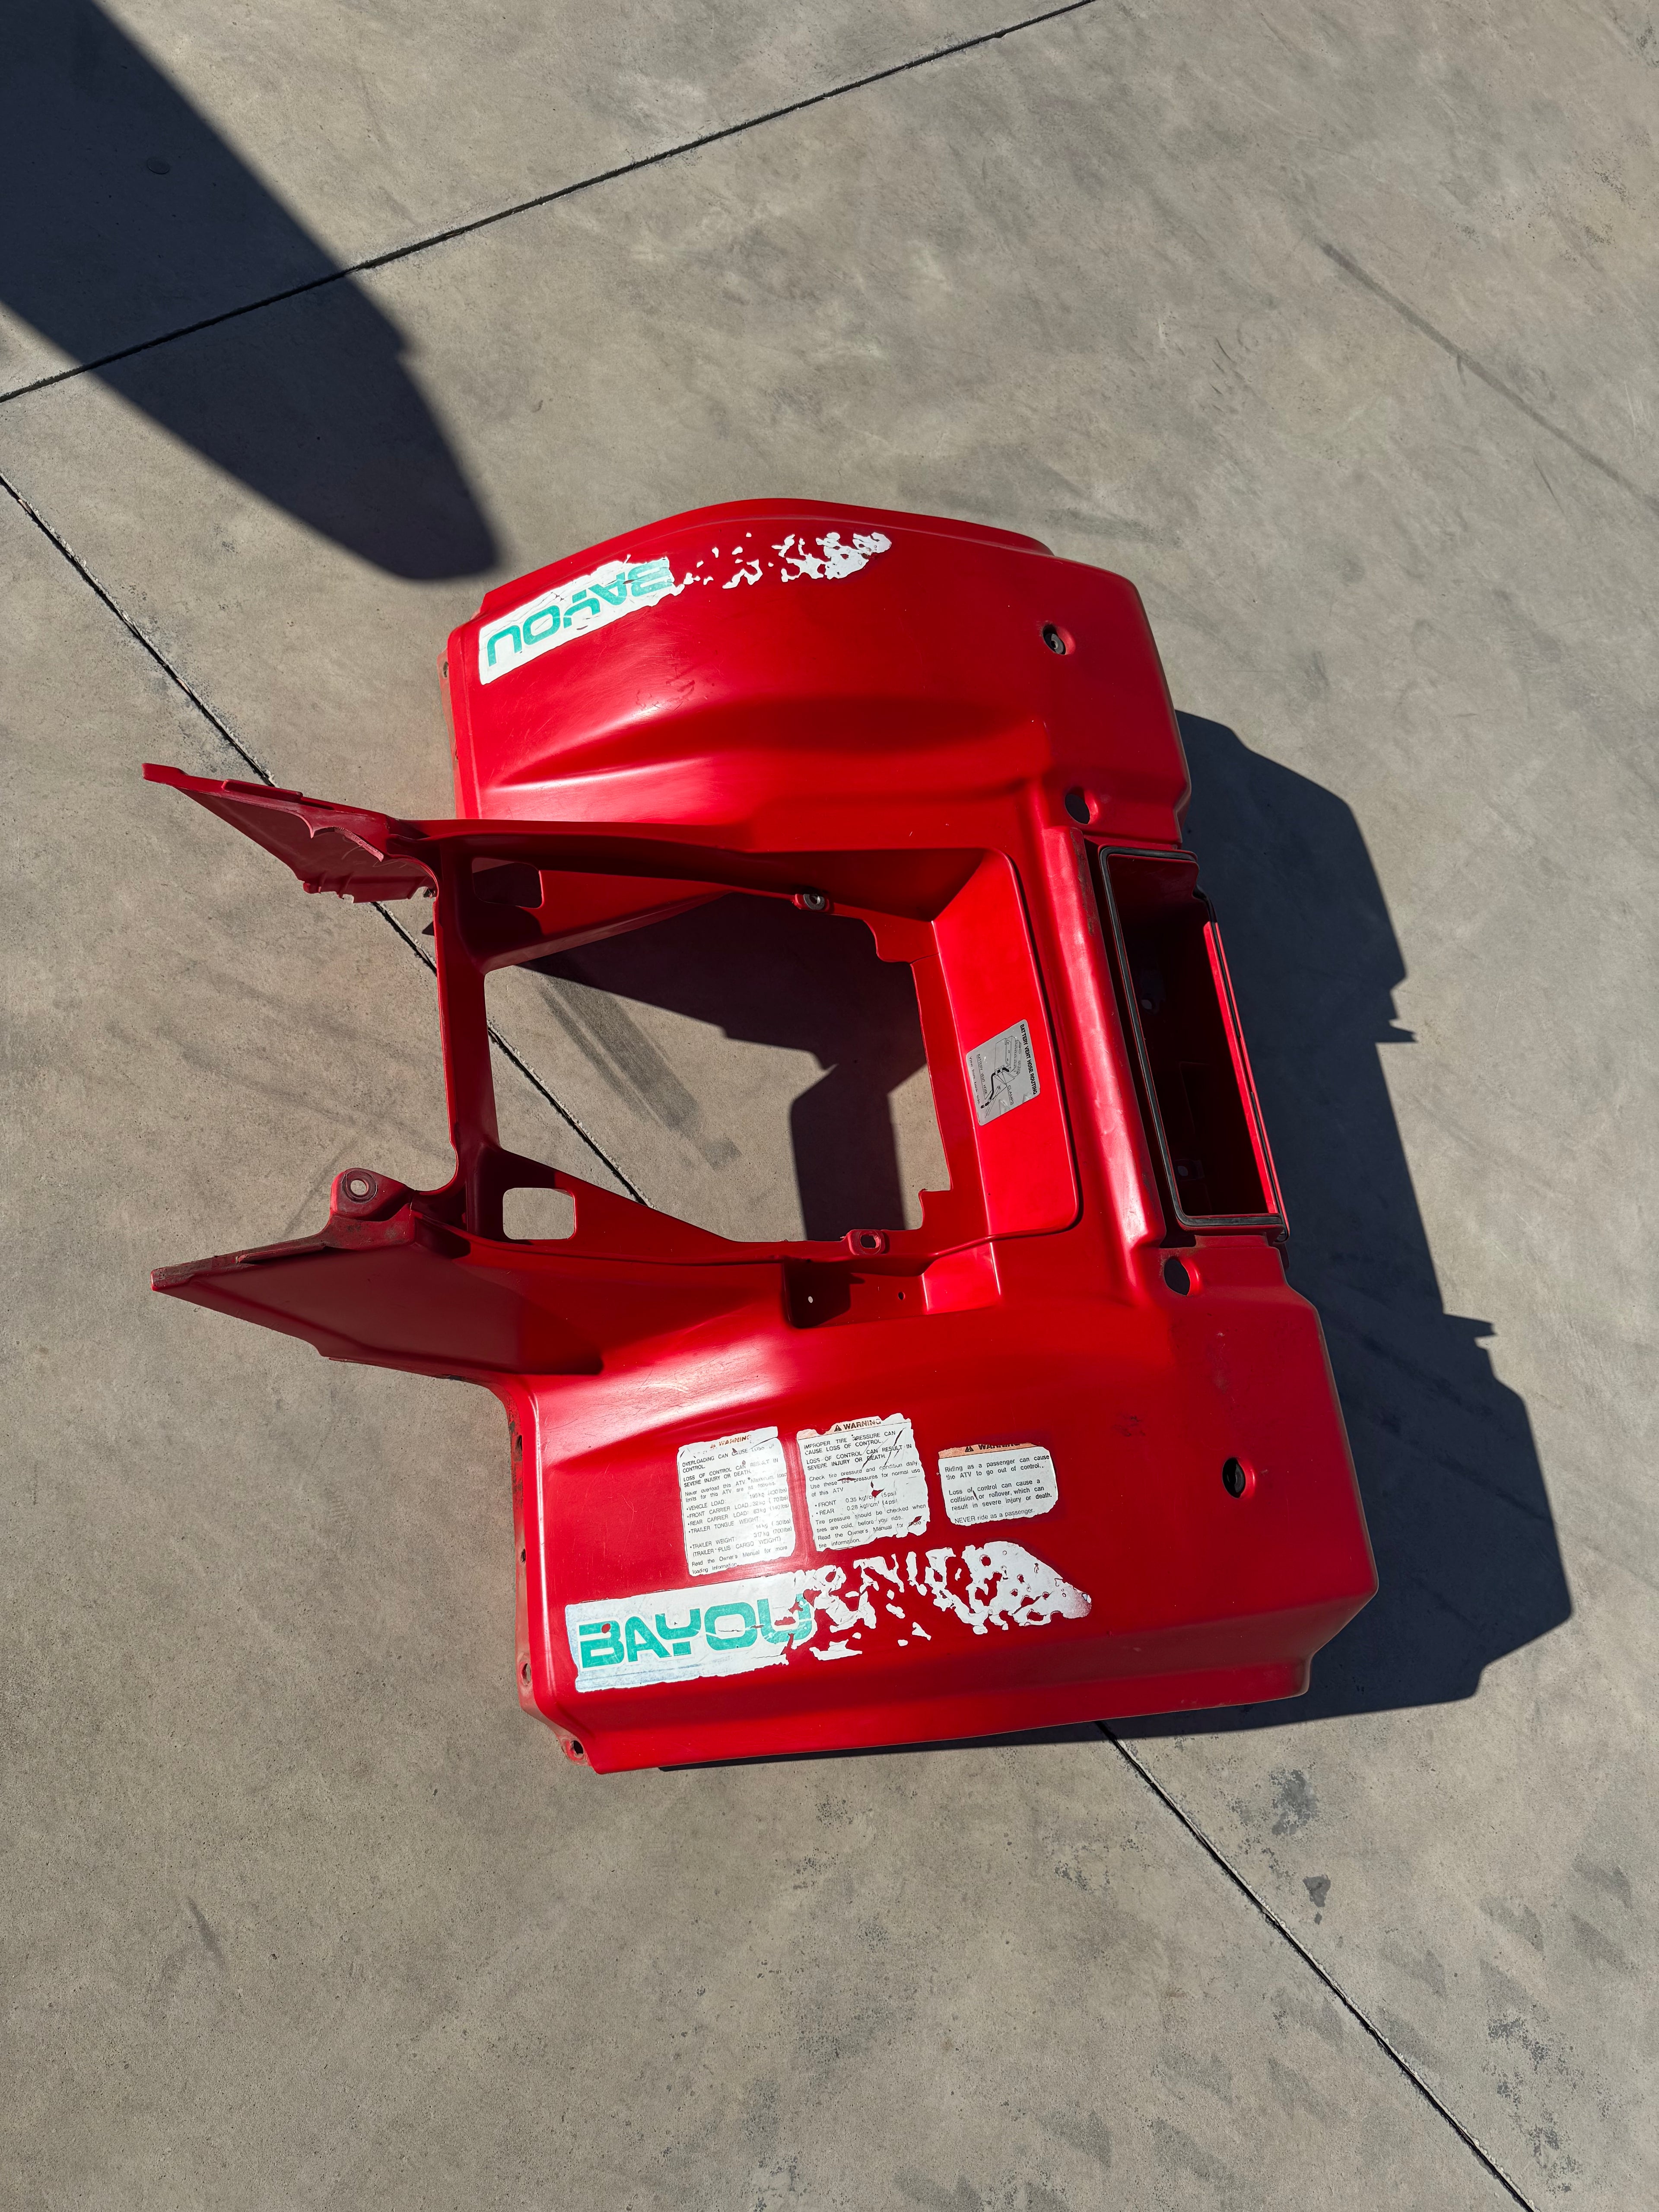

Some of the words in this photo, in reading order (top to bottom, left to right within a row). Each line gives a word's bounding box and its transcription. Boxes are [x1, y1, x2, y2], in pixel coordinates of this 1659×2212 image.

[487, 560, 673, 667] BAYOU
[1020, 1023, 1028, 1045] BATTERY
[1029, 1073, 1037, 1095] ROUTING
[842, 1418, 881, 1430] WARNING
[804, 1440, 830, 1449] IMPROPER
[836, 1451, 862, 1459] CONTROL
[682, 1456, 715, 1467] OVERLOADING
[986, 1459, 1015, 1468] passenger
[682, 1464, 705, 1473] CONTROL
[807, 1462, 827, 1471] SEVERE
[709, 1467, 732, 1476] CONTROL
[683, 1479, 701, 1487] SEVERE
[700, 1485, 719, 1493] overload
[688, 1502, 708, 1511] VEHICLE
[818, 1499, 836, 1507] FRONT
[689, 1510, 705, 1519] FRONT
[709, 1506, 730, 1515] CARRIER
[954, 1516, 976, 1525] NEVER
[1004, 1508, 1035, 1517] passenger.
[707, 1514, 728, 1522] CARRIER
[829, 1515, 850, 1523] pressure
[690, 1525, 710, 1533] TRAILER
[714, 1520, 734, 1529] TONGUE
[873, 1524, 892, 1532] Manual
[692, 1541, 712, 1549] TRAILER
[693, 1548, 714, 1557] (TRAILER
[735, 1541, 754, 1549] CARGO
[579, 1593, 811, 1668] BAYOU
